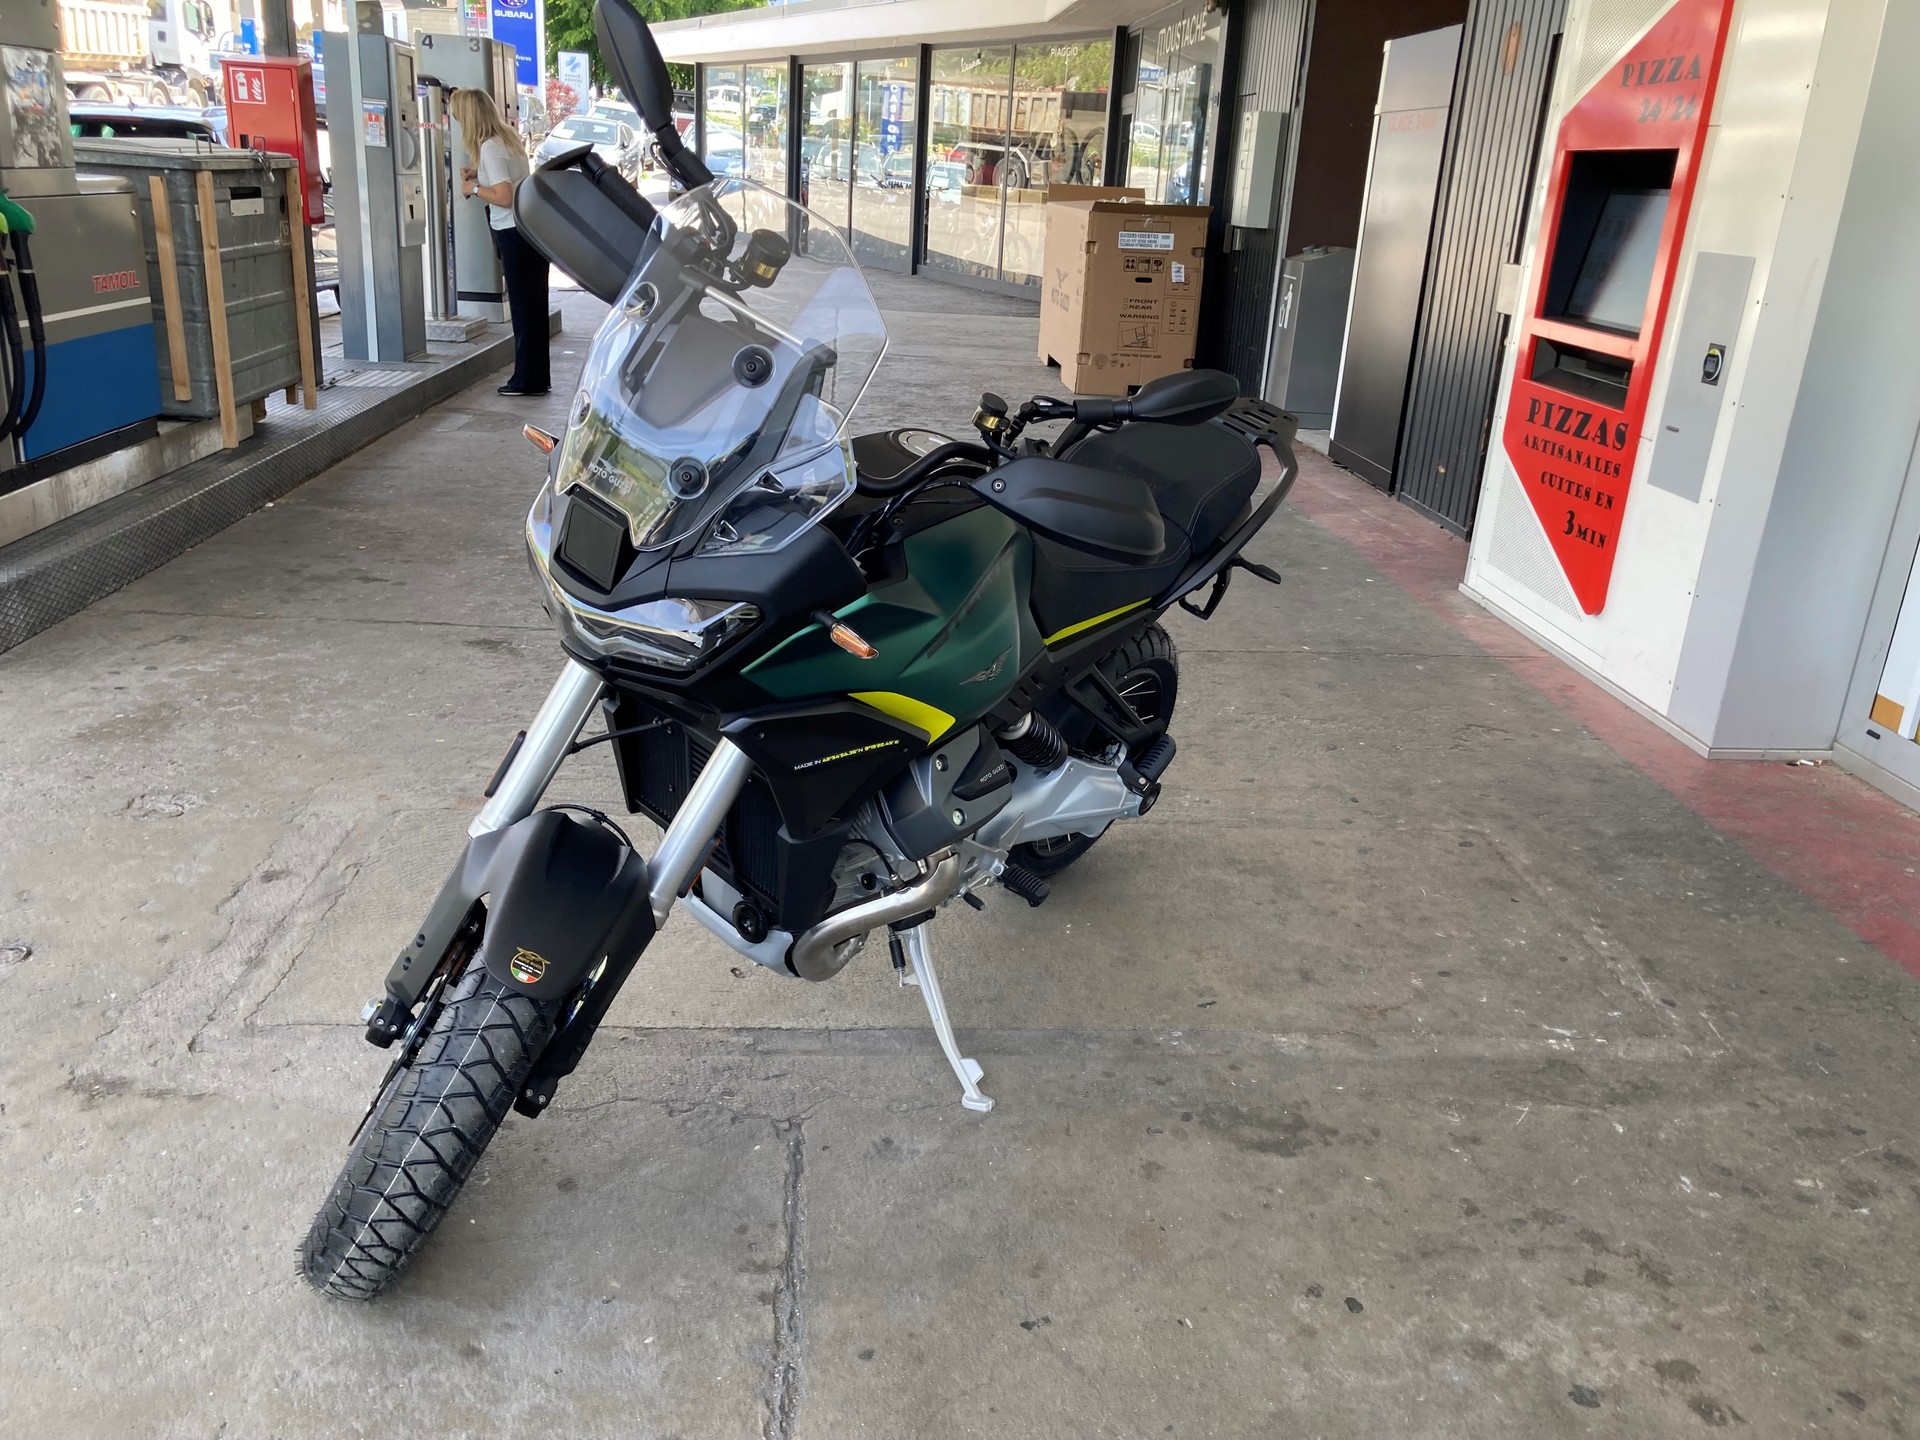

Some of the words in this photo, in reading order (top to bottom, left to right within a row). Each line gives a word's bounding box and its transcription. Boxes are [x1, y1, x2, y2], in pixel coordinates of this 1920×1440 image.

[494, 9, 534, 20] SUBARU
[421, 34, 434, 50] 4
[468, 37, 481, 53] 3
[1050, 46, 1079, 57] PIAGGIO
[1618, 52, 1702, 88] PIZZA
[1636, 92, 1697, 124] 24/24
[92, 270, 141, 294] TAMOIL
[1525, 396, 1630, 451] PIZZAS
[1521, 433, 1622, 479] ARTISANALES
[587, 461, 608, 479] MOTO
[1540, 470, 1592, 502] CUITES
[1594, 490, 1616, 511] EN
[794, 761, 814, 770] MADE
[979, 772, 993, 784] MOTO
[991, 763, 1005, 775] GUZZI
